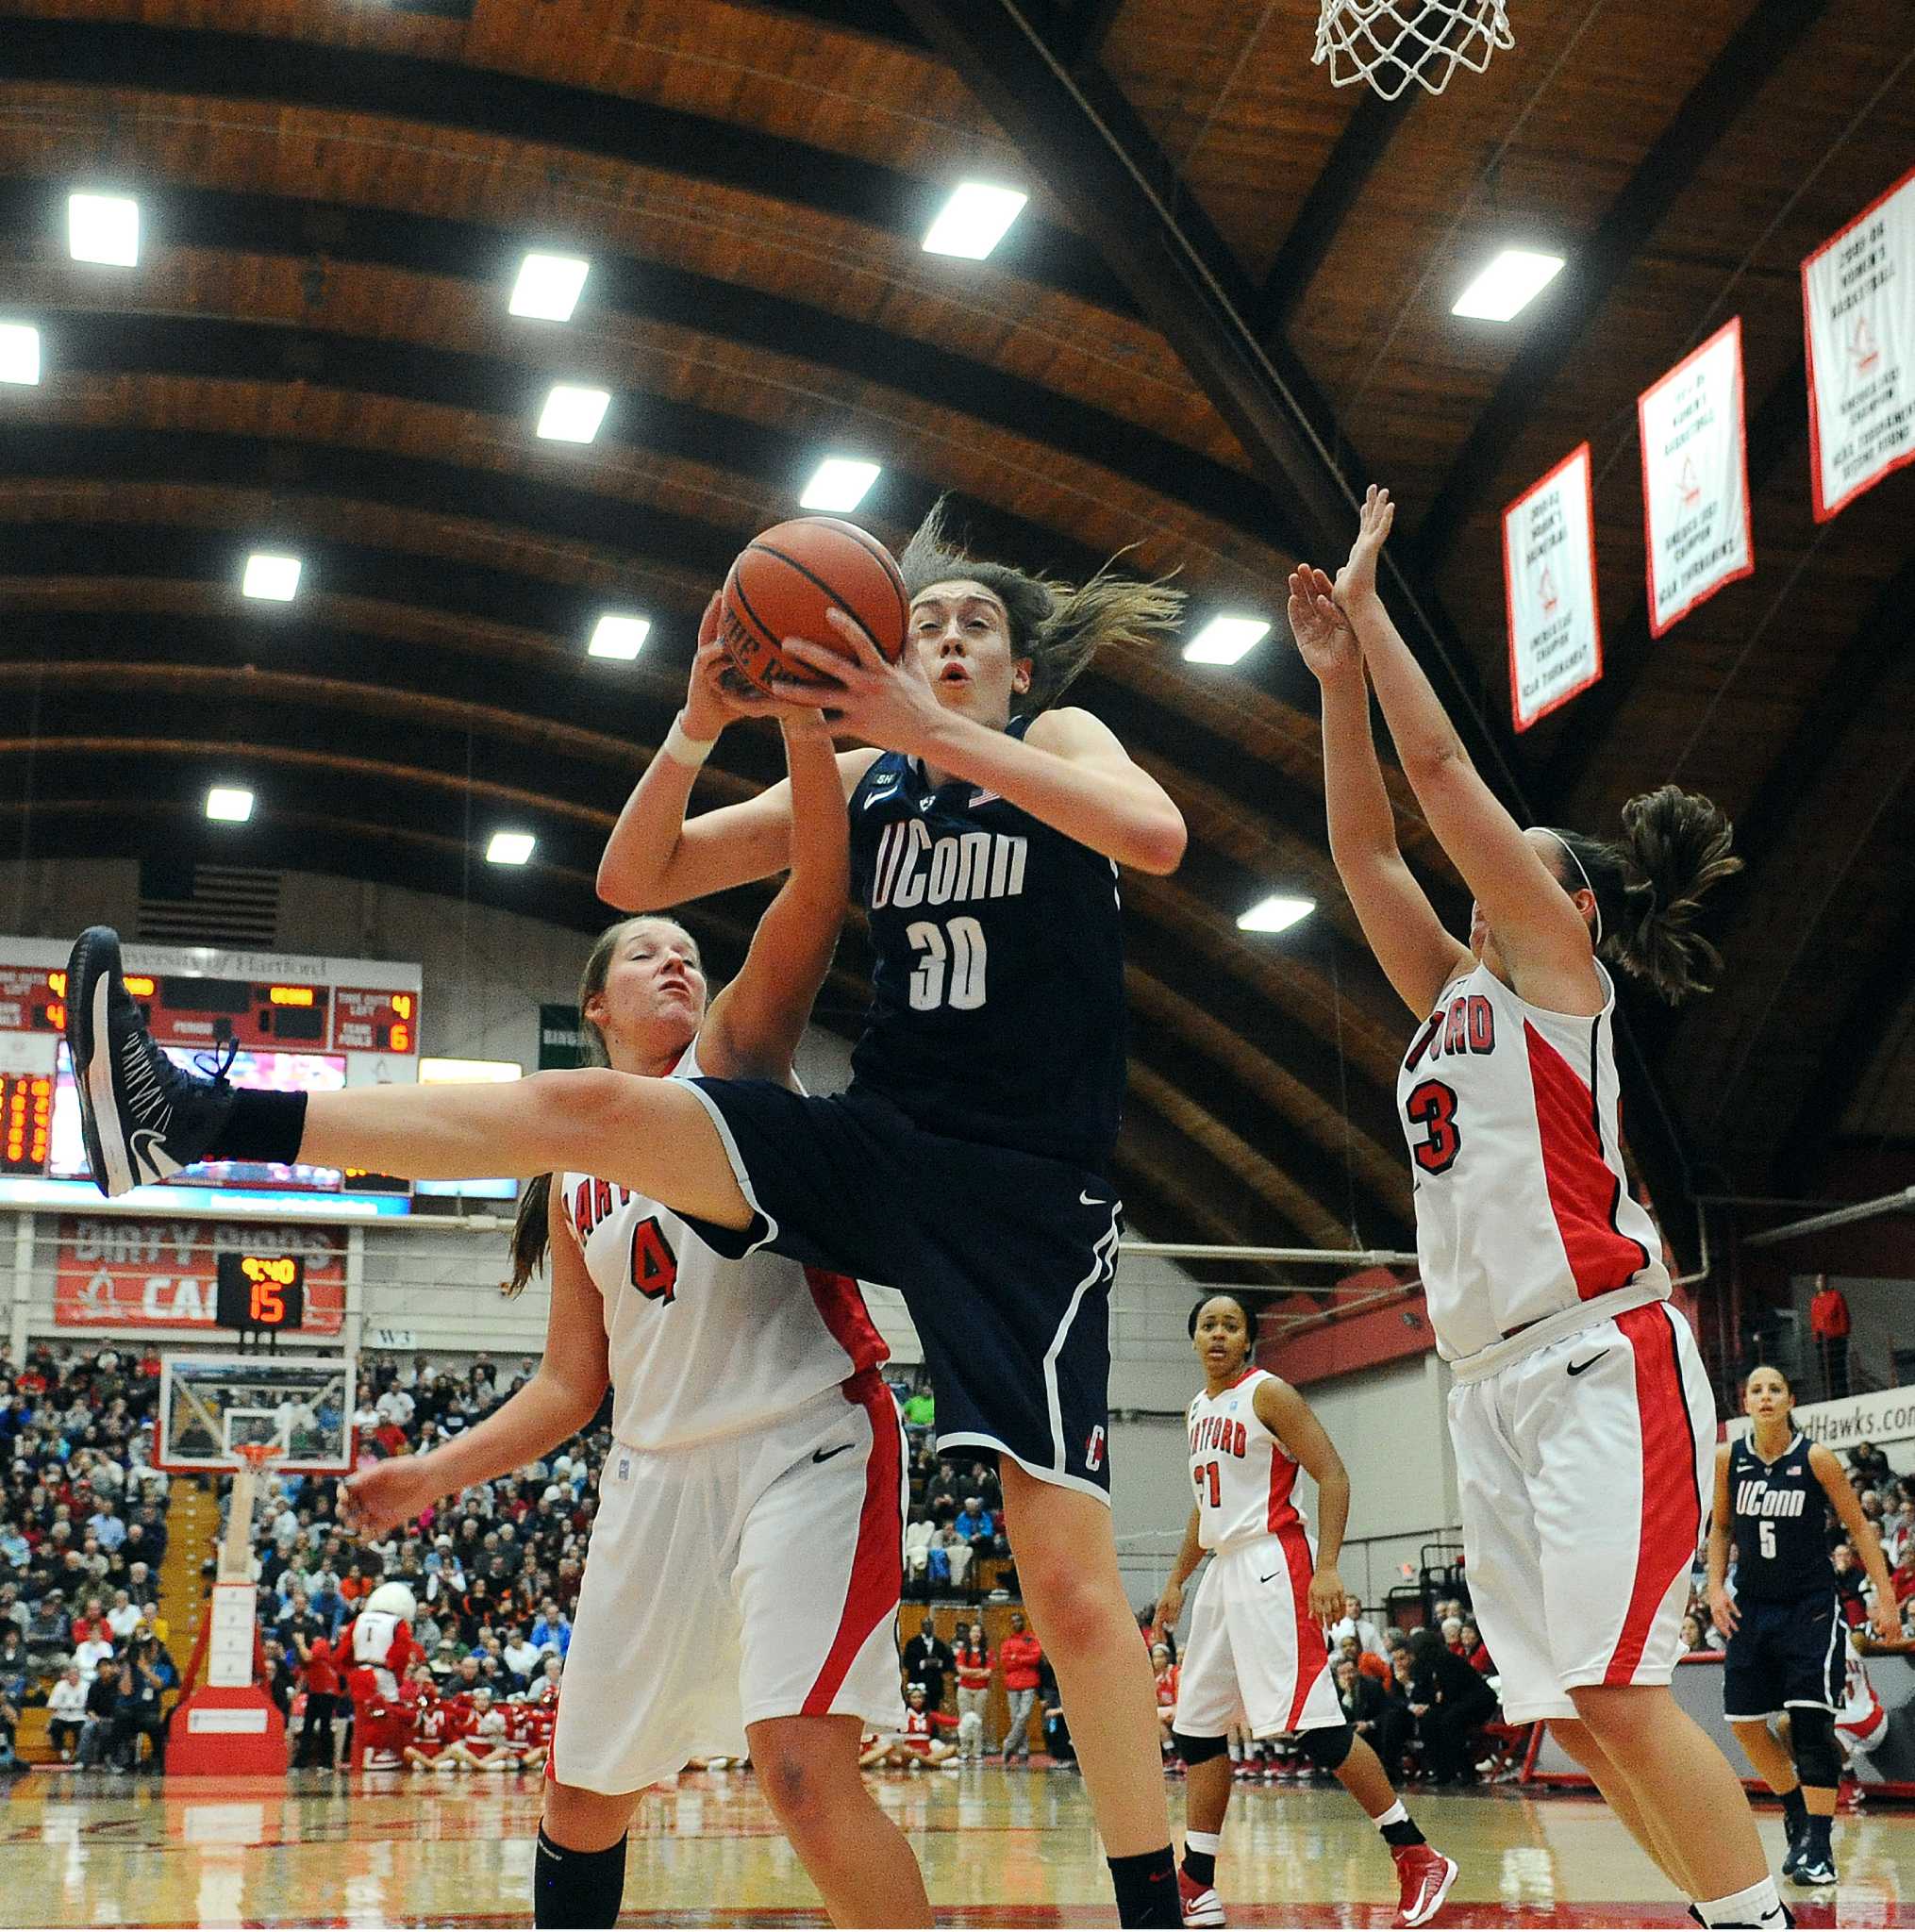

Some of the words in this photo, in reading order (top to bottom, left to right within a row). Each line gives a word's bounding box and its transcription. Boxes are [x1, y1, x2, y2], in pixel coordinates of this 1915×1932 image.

[906, 916, 988, 1010] 30
[49, 973, 65, 997] 4
[47, 1005, 64, 1029] 4
[391, 994, 410, 1020] 4
[390, 1024, 408, 1051] 6
[241, 1257, 295, 1285] 9:40
[631, 1215, 678, 1307] 4
[251, 1282, 284, 1323] 15
[1759, 1521, 1776, 1559] 5
